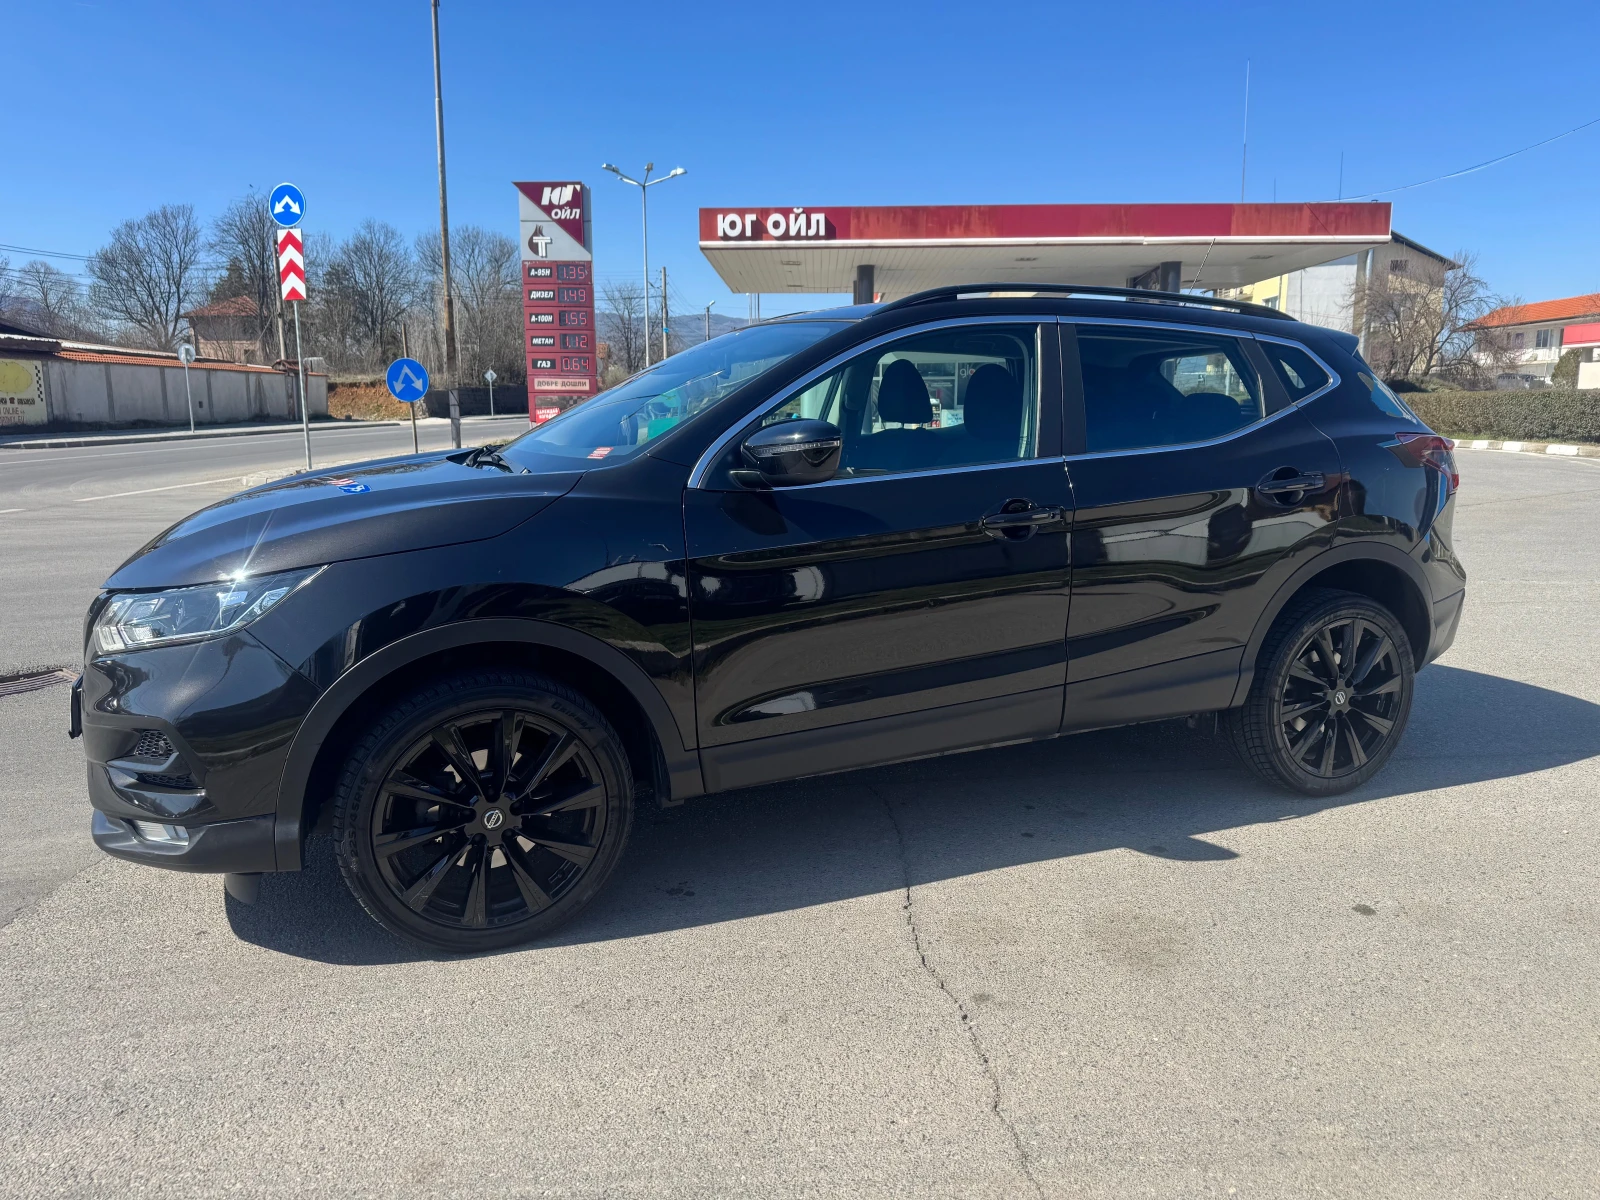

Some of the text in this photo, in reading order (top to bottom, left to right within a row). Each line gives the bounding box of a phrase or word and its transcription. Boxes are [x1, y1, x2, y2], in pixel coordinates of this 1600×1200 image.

[551, 206, 581, 220] ОЙЛ
[717, 207, 826, 237] ЮГ ОЙЛ
[563, 266, 586, 279] 1.35
[530, 289, 586, 302] ДИЗЕЛ 1.49
[565, 312, 588, 325] 1.55
[532, 335, 588, 348] МЕТАН 1.12
[537, 360, 551, 368] ГАЗ
[536, 380, 587, 388] ДОБРЕ ДОШЛИ
